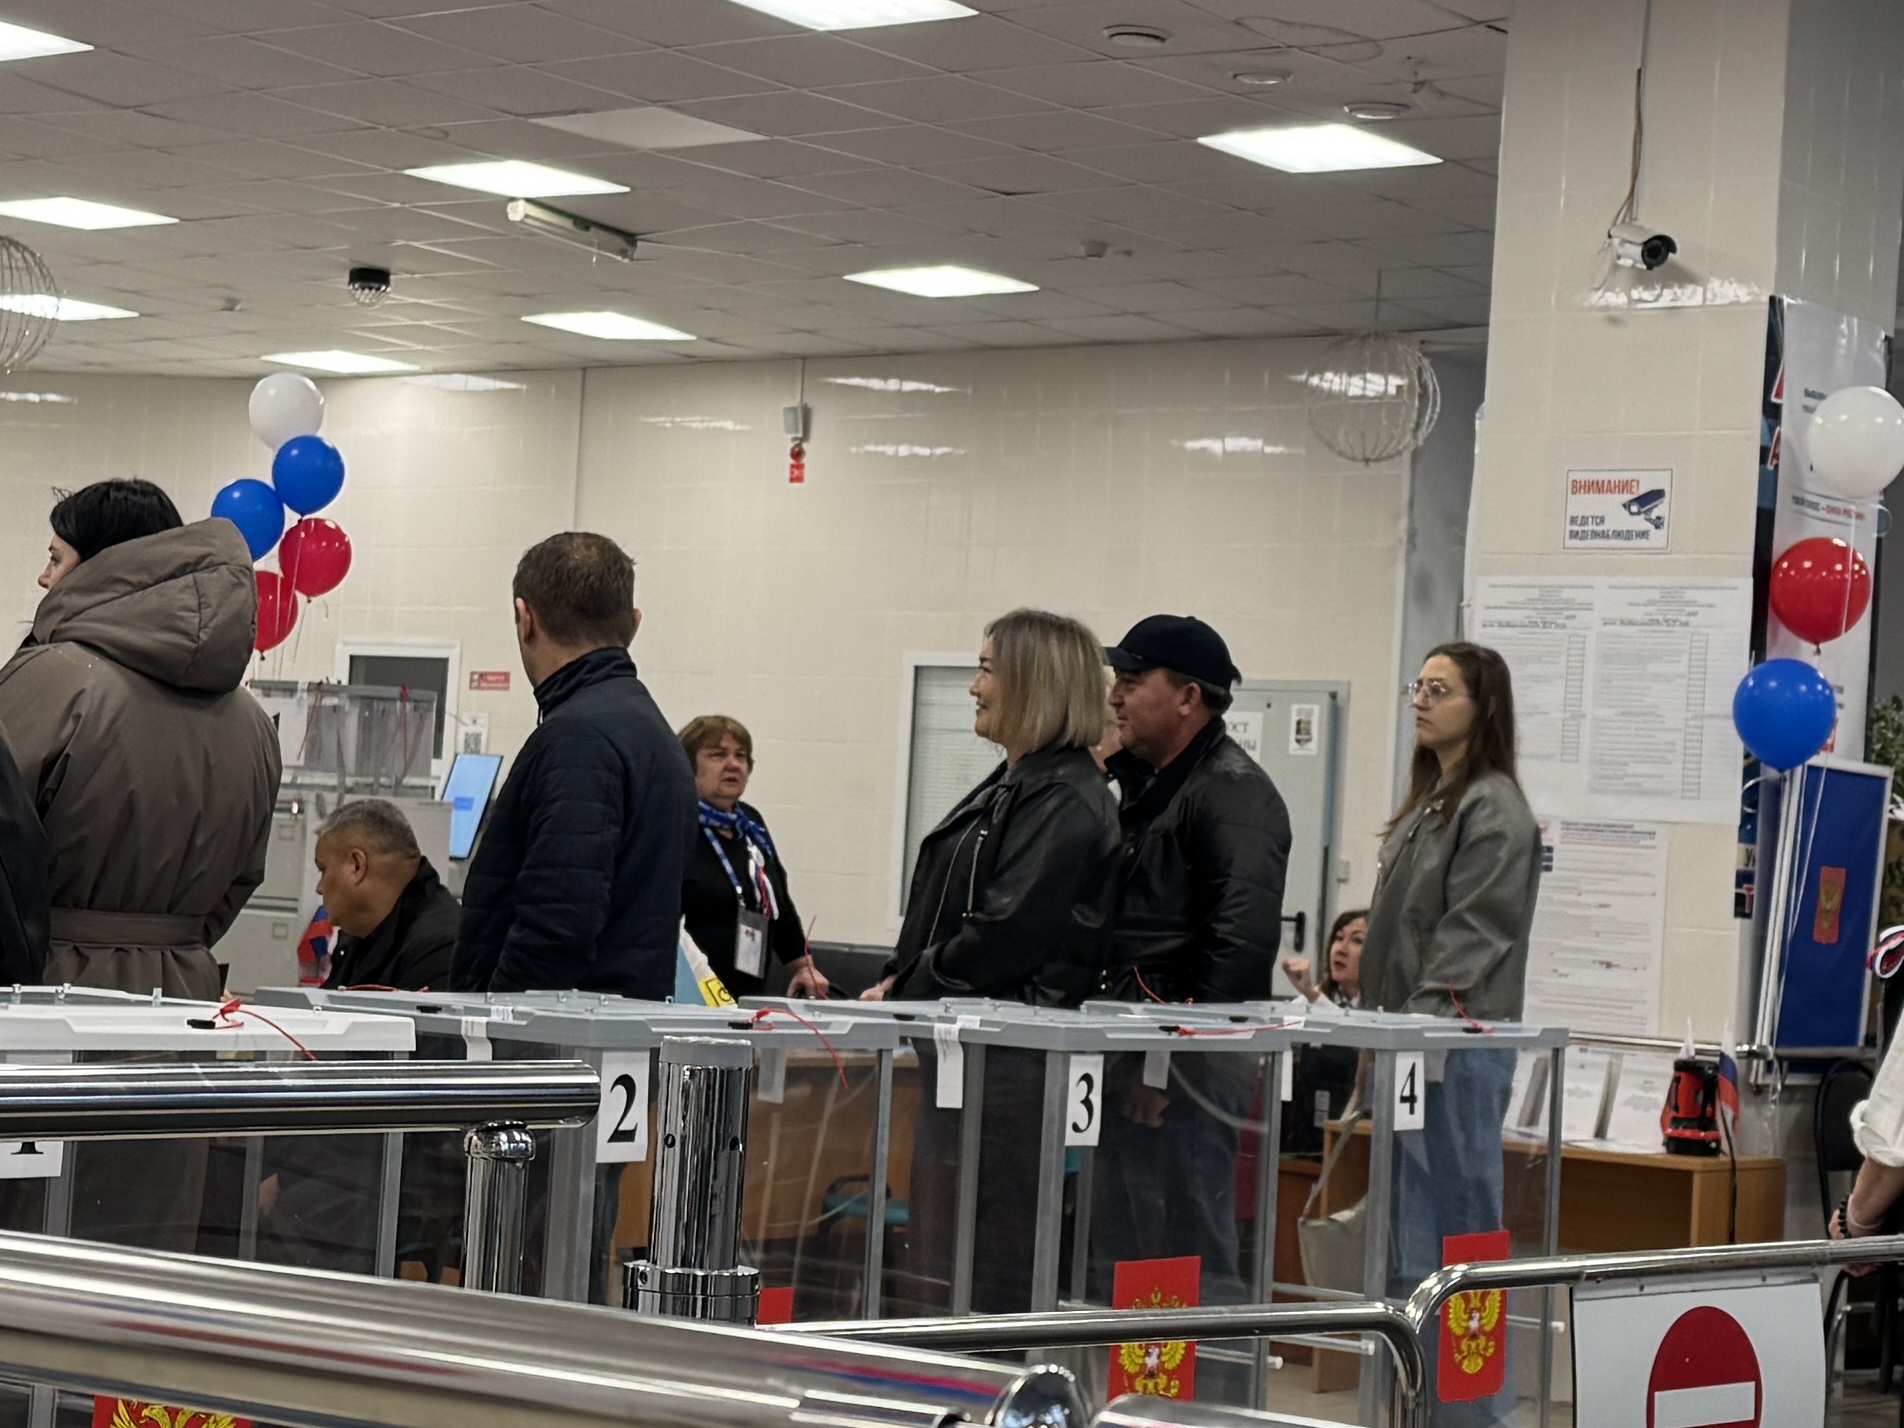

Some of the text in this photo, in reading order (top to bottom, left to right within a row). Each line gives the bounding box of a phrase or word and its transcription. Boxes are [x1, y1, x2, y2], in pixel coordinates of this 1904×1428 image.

[1571, 478, 1640, 496] ВНИМАНИЕ!
[1568, 528, 1650, 541] ВИДЕОНАБЛЮДЕНИЕ
[1569, 514, 1606, 527] ВЕДЕТСЯ
[1071, 1072, 1095, 1134] 3
[1399, 1061, 1417, 1115] 4
[607, 1073, 638, 1143] 2
